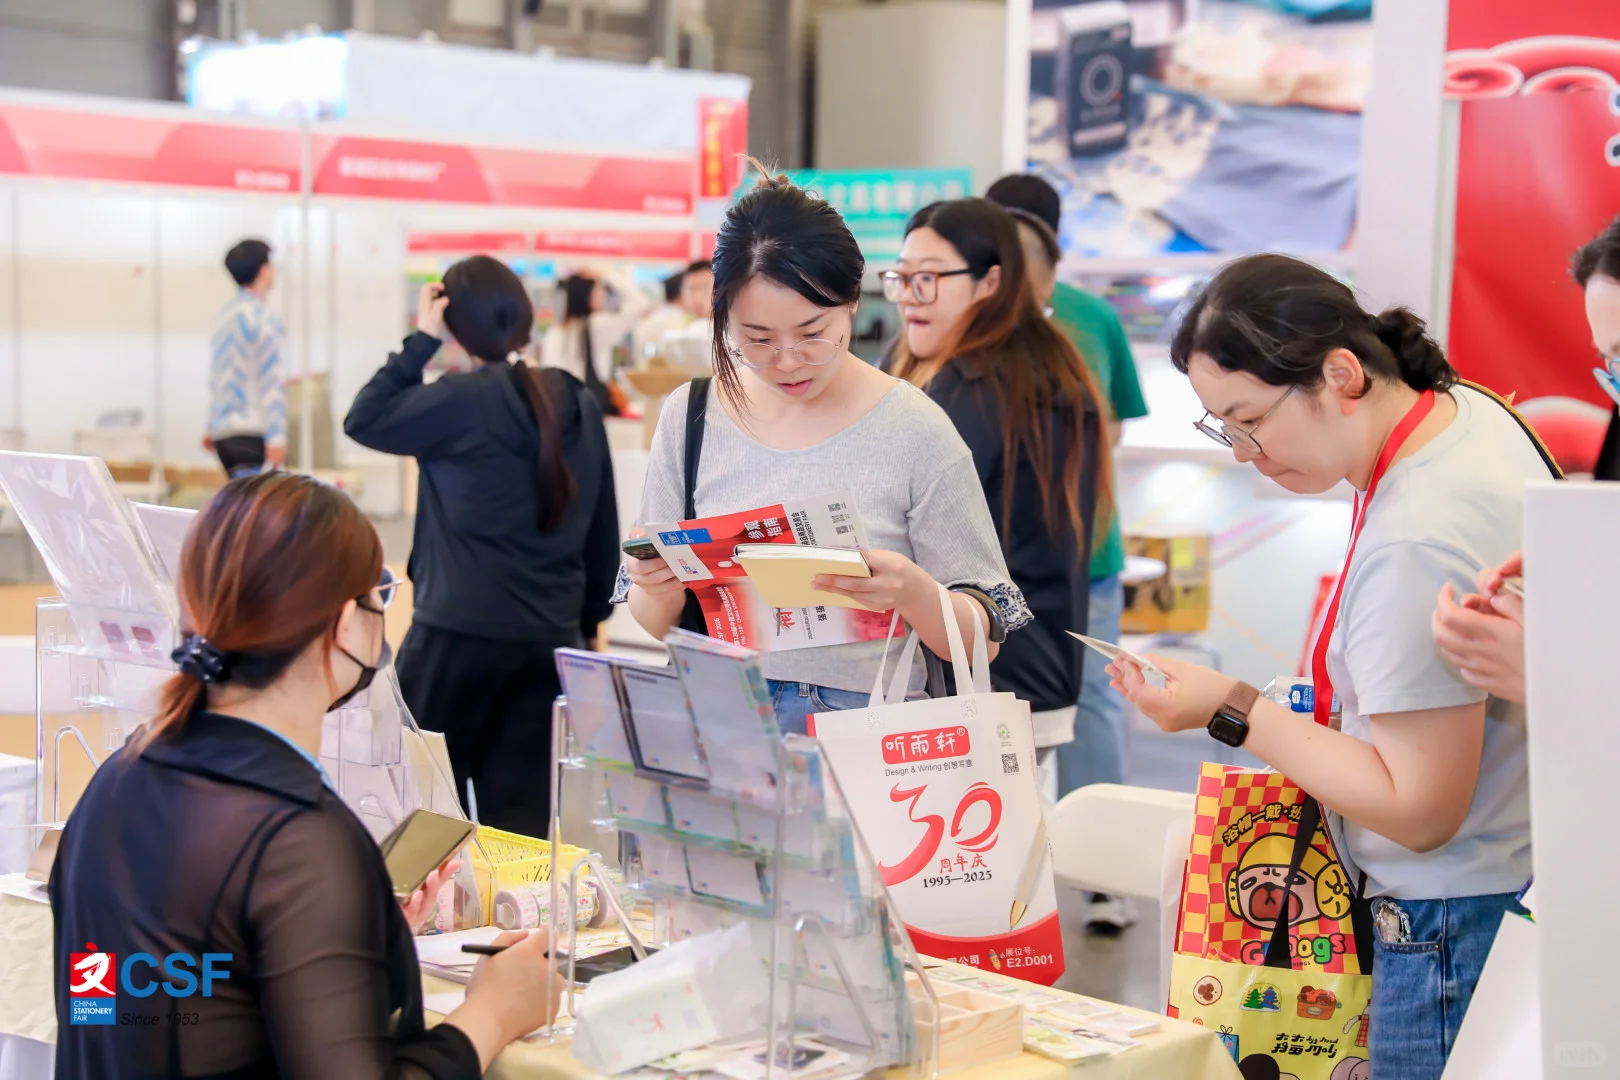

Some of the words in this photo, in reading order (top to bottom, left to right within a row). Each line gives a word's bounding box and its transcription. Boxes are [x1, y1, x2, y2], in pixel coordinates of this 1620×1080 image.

[744, 520, 765, 540] 参观
[763, 517, 784, 538] 指南
[885, 767, 909, 777] Design
[911, 765, 917, 773] &
[918, 762, 942, 773] Writing
[940, 853, 988, 874] 周年庆
[1006, 954, 1054, 968] E2.D001
